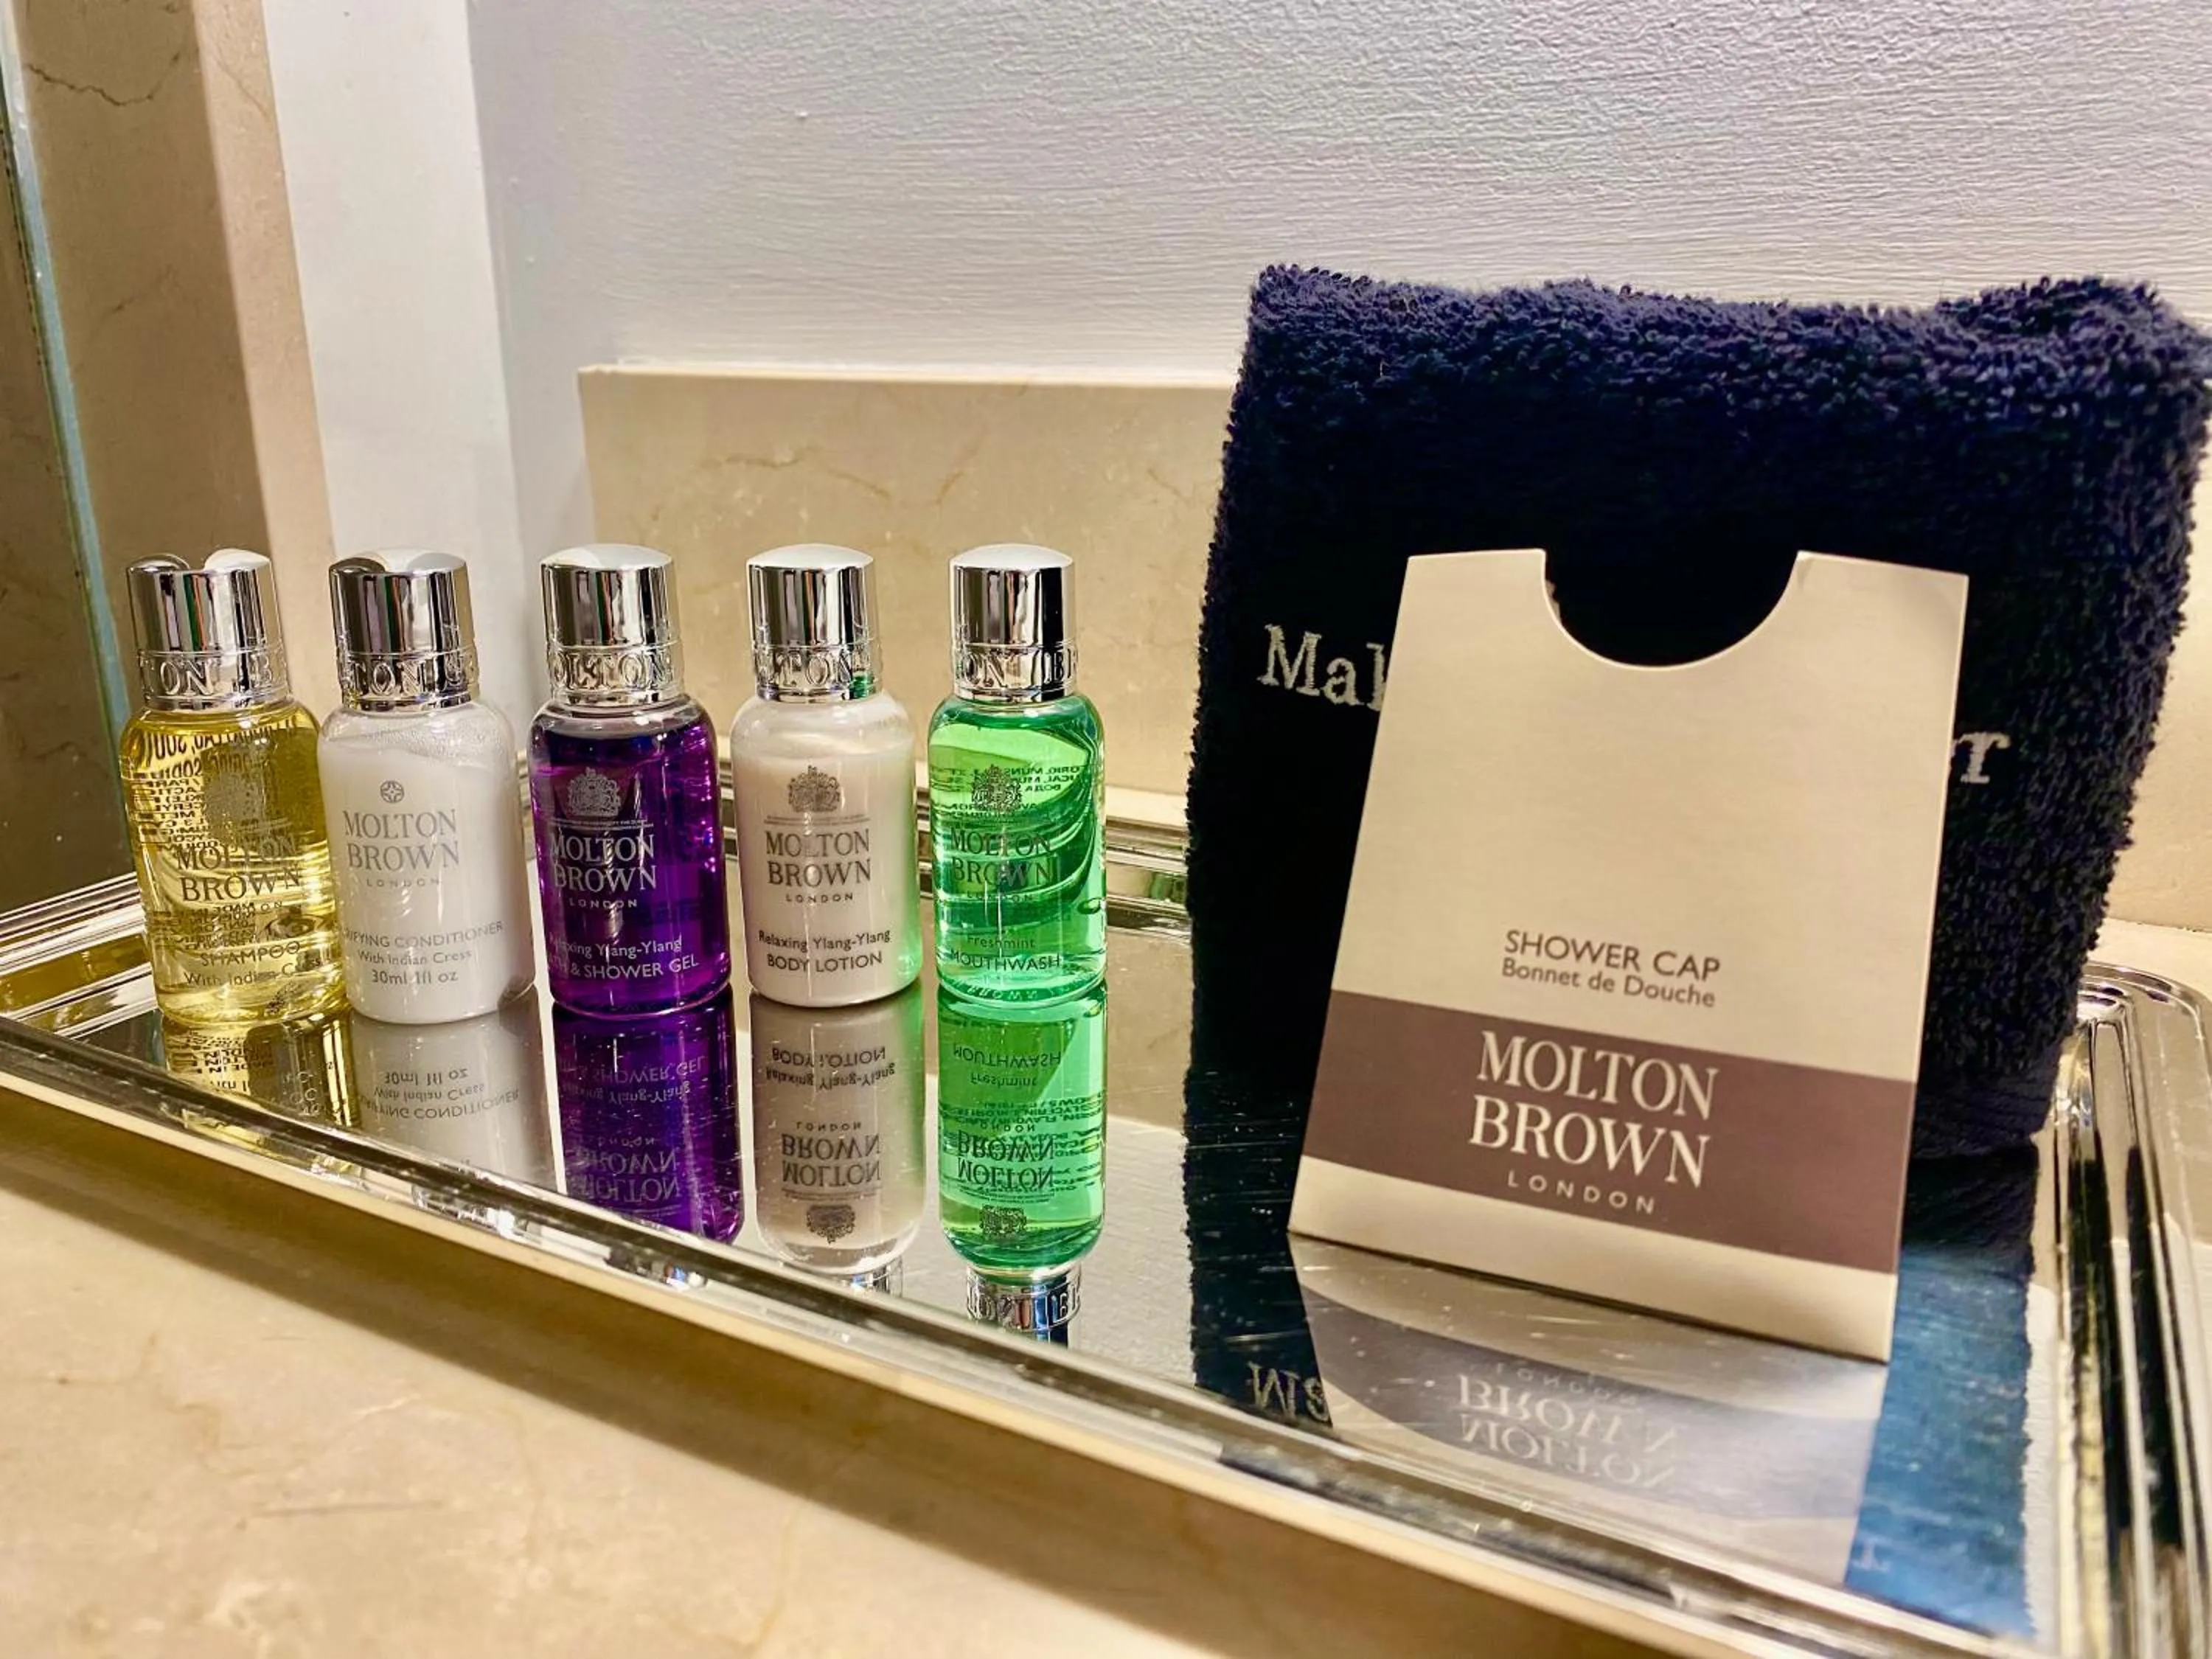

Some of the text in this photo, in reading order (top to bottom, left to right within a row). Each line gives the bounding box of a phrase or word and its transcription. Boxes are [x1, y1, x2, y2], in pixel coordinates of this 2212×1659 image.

[342, 809, 458, 838] MOLTON
[347, 841, 459, 872] BROWN
[552, 834, 655, 863] MOLTON
[765, 828, 870, 858] MOLTON
[950, 827, 1051, 857] MOLTON
[179, 864, 302, 902] BROWN
[366, 877, 441, 888] LONDON
[554, 864, 657, 893] BROWN
[767, 858, 872, 888] BROWN
[951, 856, 1054, 886] BROWN
[569, 898, 638, 909] LONDON
[786, 892, 854, 903] LONDON
[394, 920, 504, 947] CONDITIONER
[759, 930, 891, 953] Relaxing Ylang-Ylang
[967, 934, 1035, 949] Freshmint
[200, 940, 301, 967] SHAMPOO
[358, 949, 473, 965] With Indian Cress
[596, 938, 682, 959] Ylang-Ylang
[767, 950, 883, 973] BODY LOTION
[950, 949, 1060, 971] MOUTHWASH
[1504, 930, 1721, 981] SHOWER CAP
[371, 969, 407, 985] 30ml
[438, 972, 459, 983] oz
[570, 962, 581, 977] &
[583, 962, 664, 980] SHOWER
[669, 953, 699, 973] GEL
[1502, 958, 1716, 1008] Bonnet de Douche
[1476, 1031, 1719, 1121] MOLTON
[1468, 1094, 1711, 1189] BROWN
[1508, 1170, 1655, 1214] LONDON
